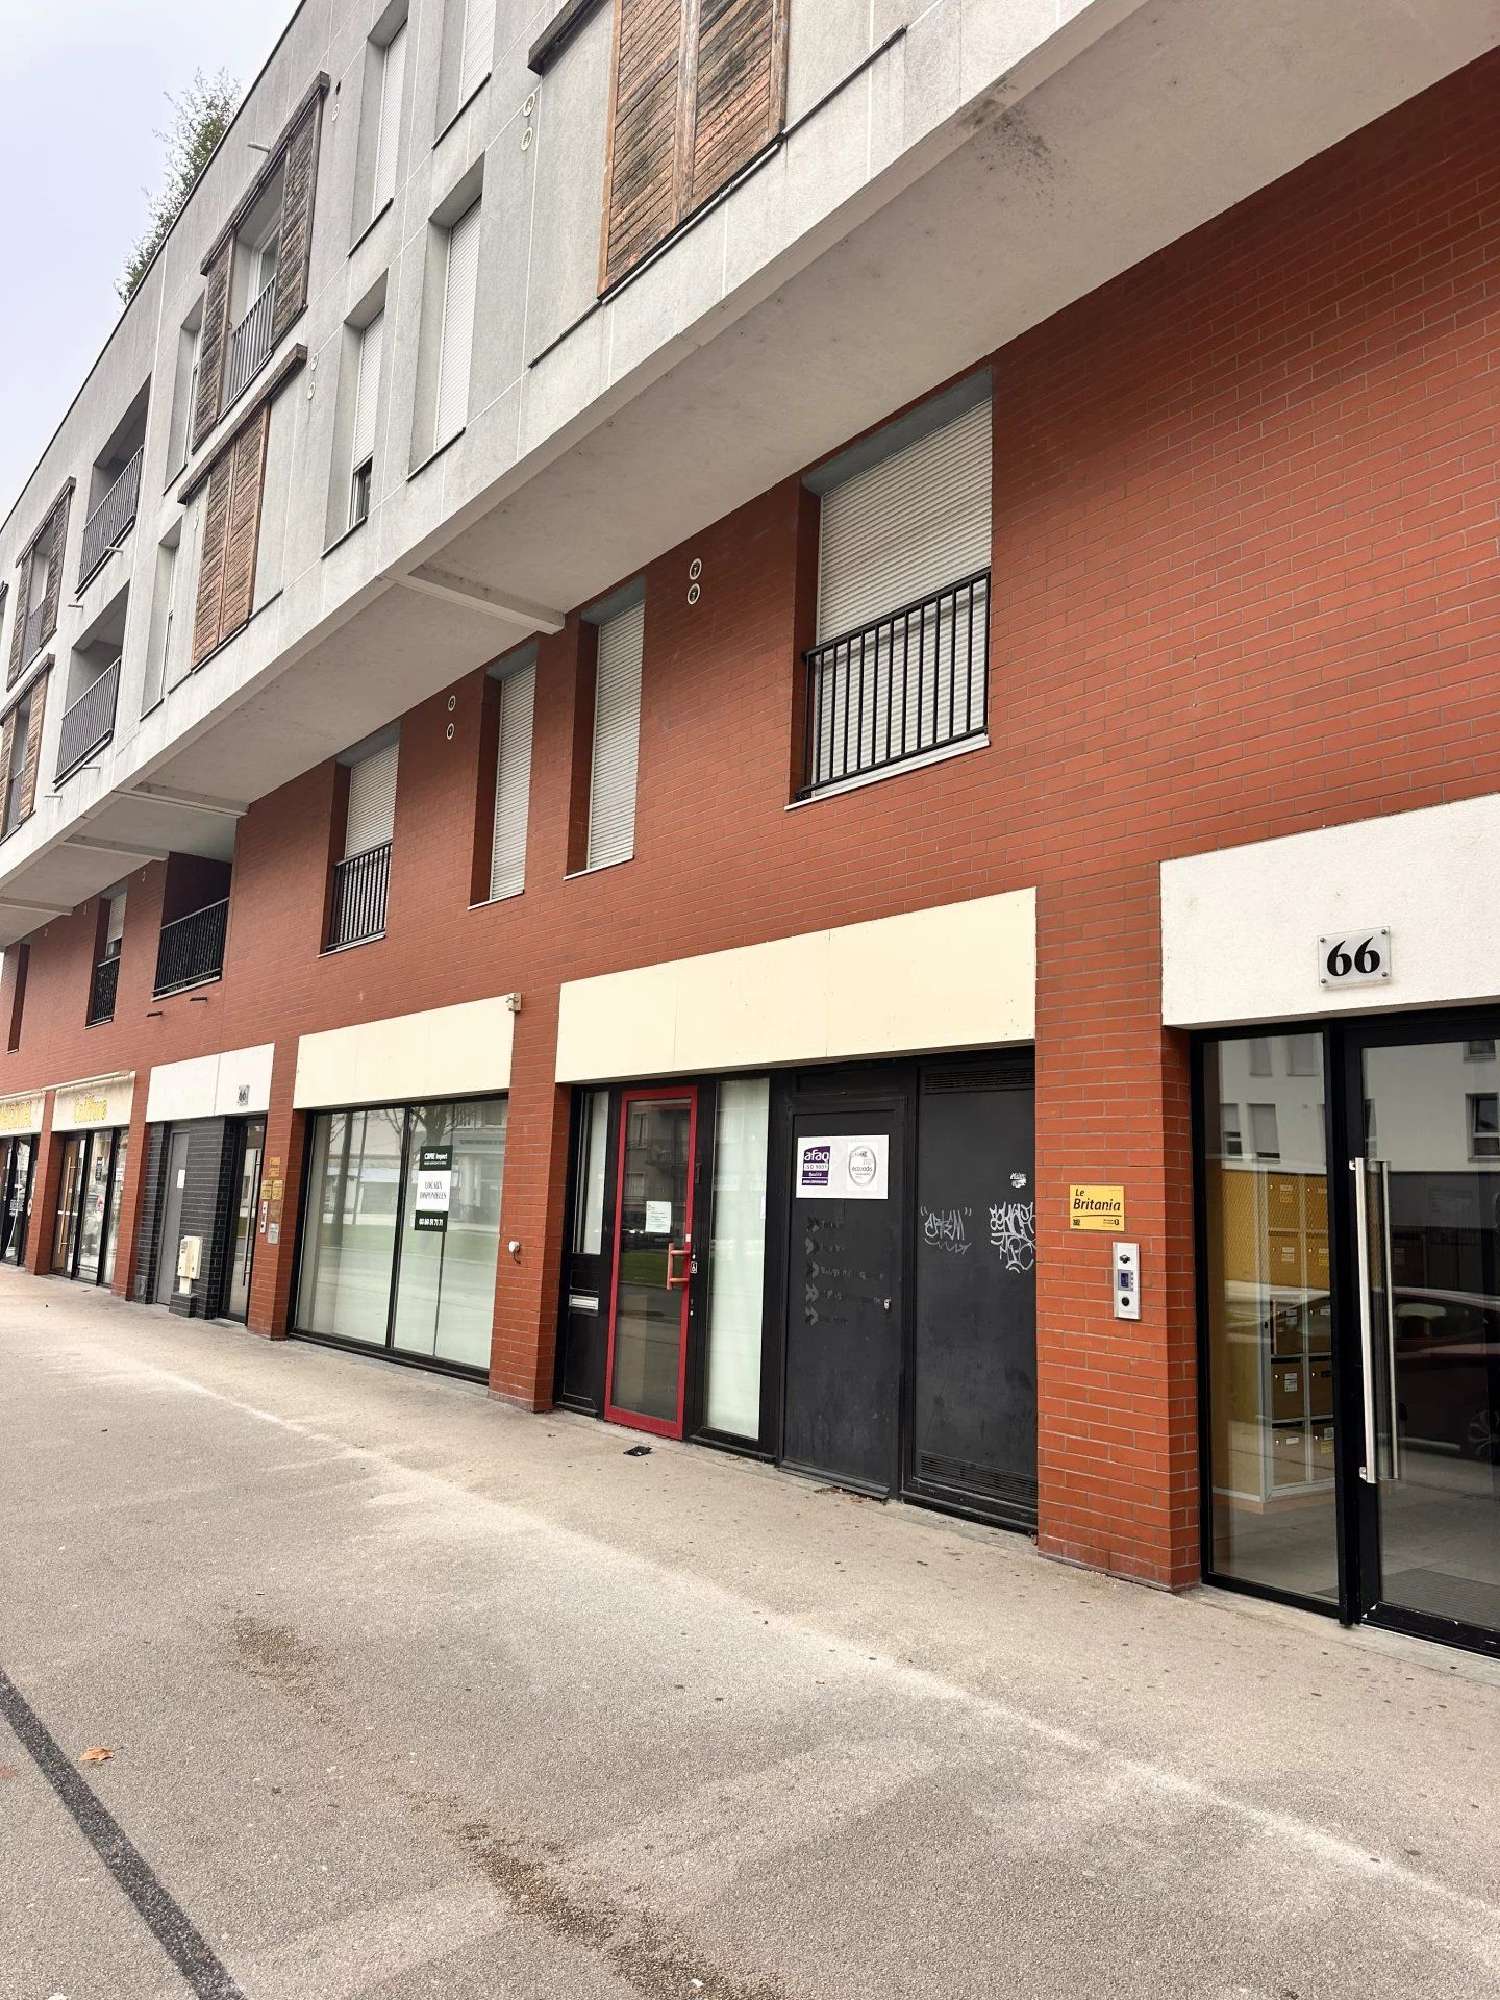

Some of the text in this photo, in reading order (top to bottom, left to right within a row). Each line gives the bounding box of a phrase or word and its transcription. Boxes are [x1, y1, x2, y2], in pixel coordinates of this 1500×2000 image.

[1327, 935, 1380, 977] 66
[1075, 1188, 1085, 1197] Le
[1073, 1197, 1121, 1211] Britania
